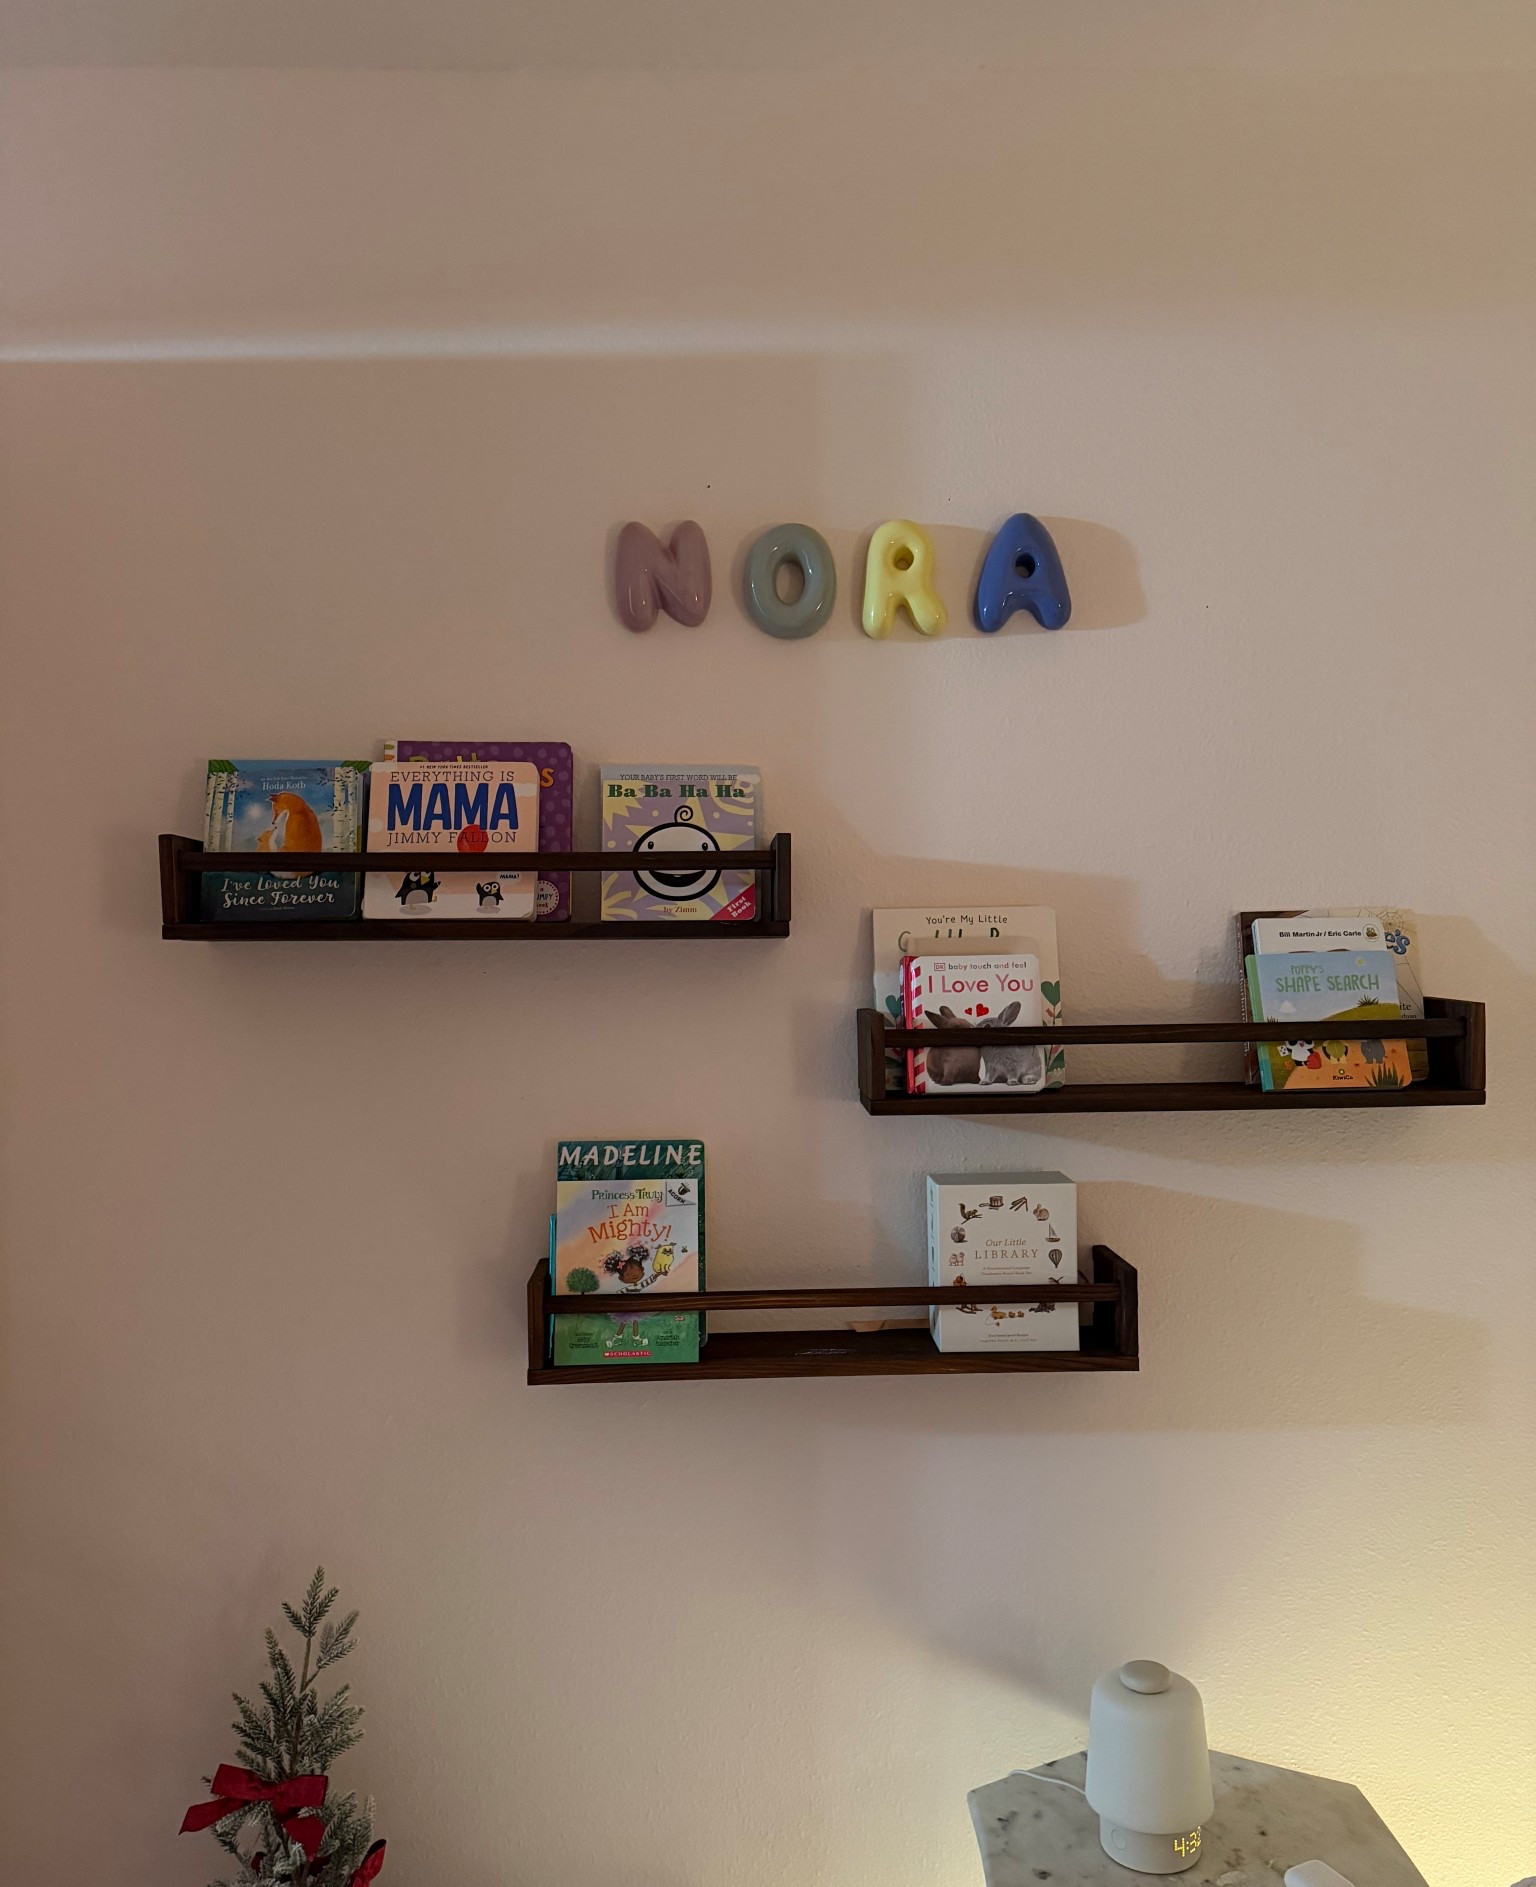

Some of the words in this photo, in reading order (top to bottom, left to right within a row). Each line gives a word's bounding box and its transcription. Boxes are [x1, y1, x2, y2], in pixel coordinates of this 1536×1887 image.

[615, 513, 1072, 640] NORA
[390, 771, 494, 782] EVERYTHING
[500, 771, 515, 782] IS
[262, 781, 284, 791] Hoda
[285, 780, 306, 790] Kotb
[607, 784, 637, 798] Ba
[642, 784, 673, 798] Ba
[678, 784, 709, 798] Ha
[715, 784, 746, 798] Ha
[387, 783, 519, 831] MAMA
[387, 832, 441, 847] JIMMY
[448, 831, 517, 843] FALLON
[221, 878, 251, 892] I've
[257, 876, 302, 891] Loved
[308, 875, 340, 890] You
[223, 892, 265, 909] Since
[270, 891, 335, 906] Forever
[726, 895, 747, 913] First
[663, 906, 673, 914] by
[731, 901, 752, 918] Book
[925, 915, 956, 925] You're
[960, 915, 974, 926] My
[978, 915, 1008, 924] Little
[948, 963, 968, 972] baby
[970, 962, 992, 970] touch
[1290, 964, 1325, 975] POPPY'S
[928, 975, 932, 993] I
[941, 975, 989, 993] Love
[995, 973, 1034, 992] You
[1275, 975, 1322, 993] SHAPE
[1326, 974, 1380, 991] SEARCH
[558, 1144, 703, 1167] MADELINE
[591, 1189, 634, 1201] Princess
[668, 1188, 686, 1204] ACORN
[607, 1204, 617, 1219] I
[623, 1203, 649, 1218] Am
[587, 1218, 673, 1244] Mighty!
[985, 1239, 1003, 1247] Our
[1004, 1238, 1027, 1246] Little
[974, 1248, 1039, 1260] LIBRARY
